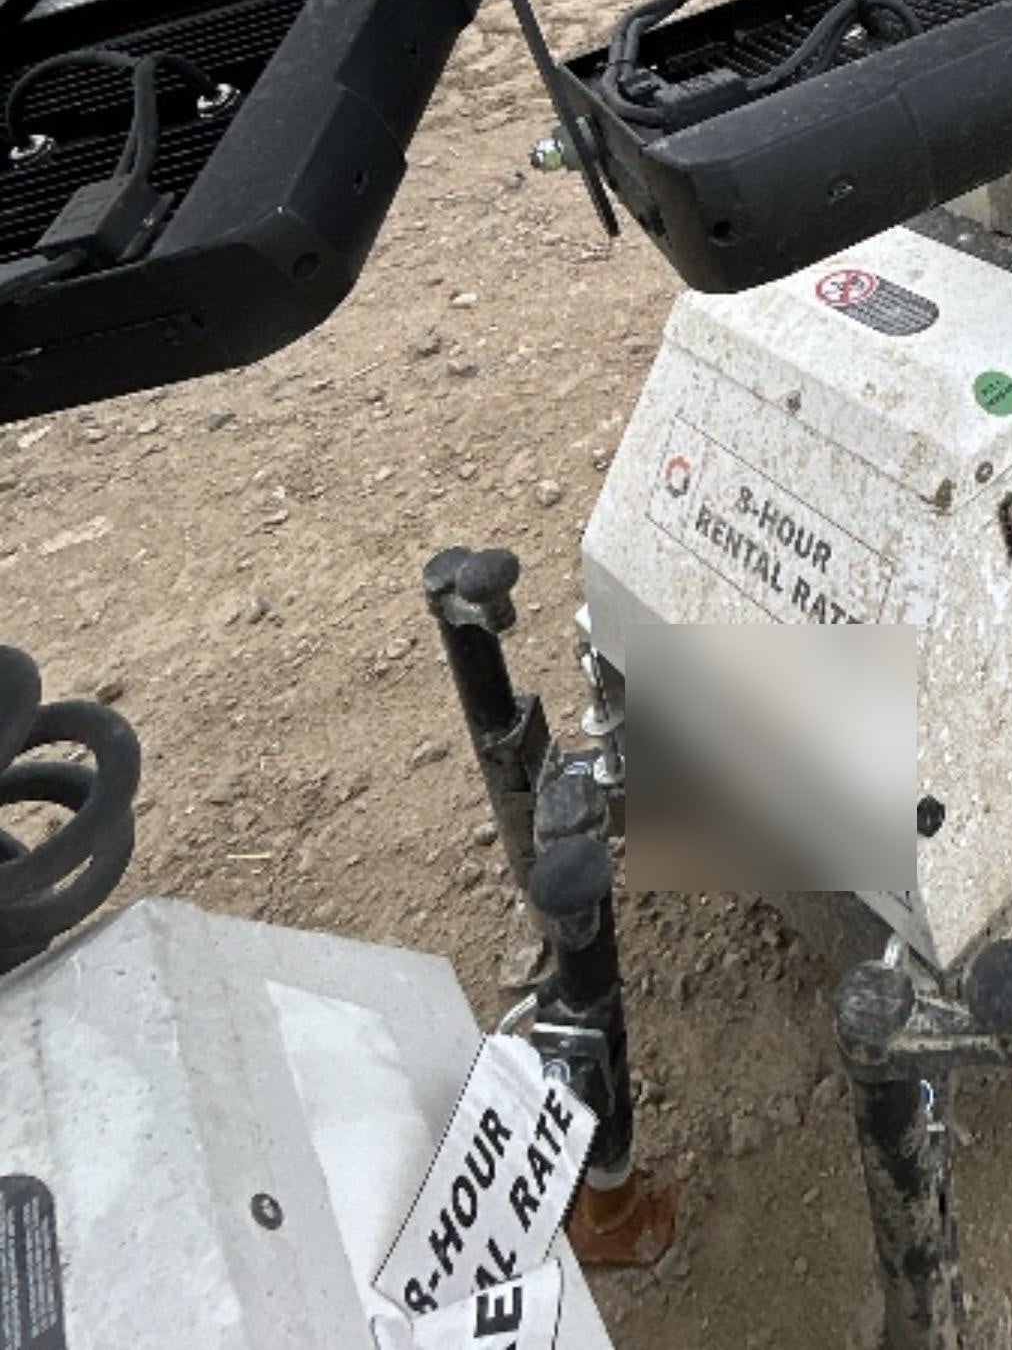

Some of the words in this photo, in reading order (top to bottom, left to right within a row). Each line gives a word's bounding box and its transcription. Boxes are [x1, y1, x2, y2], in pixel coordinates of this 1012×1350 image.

[695, 503, 784, 593] RENTAL
[736, 485, 833, 574] 8-HOUR
[509, 1088, 574, 1233] RATE
